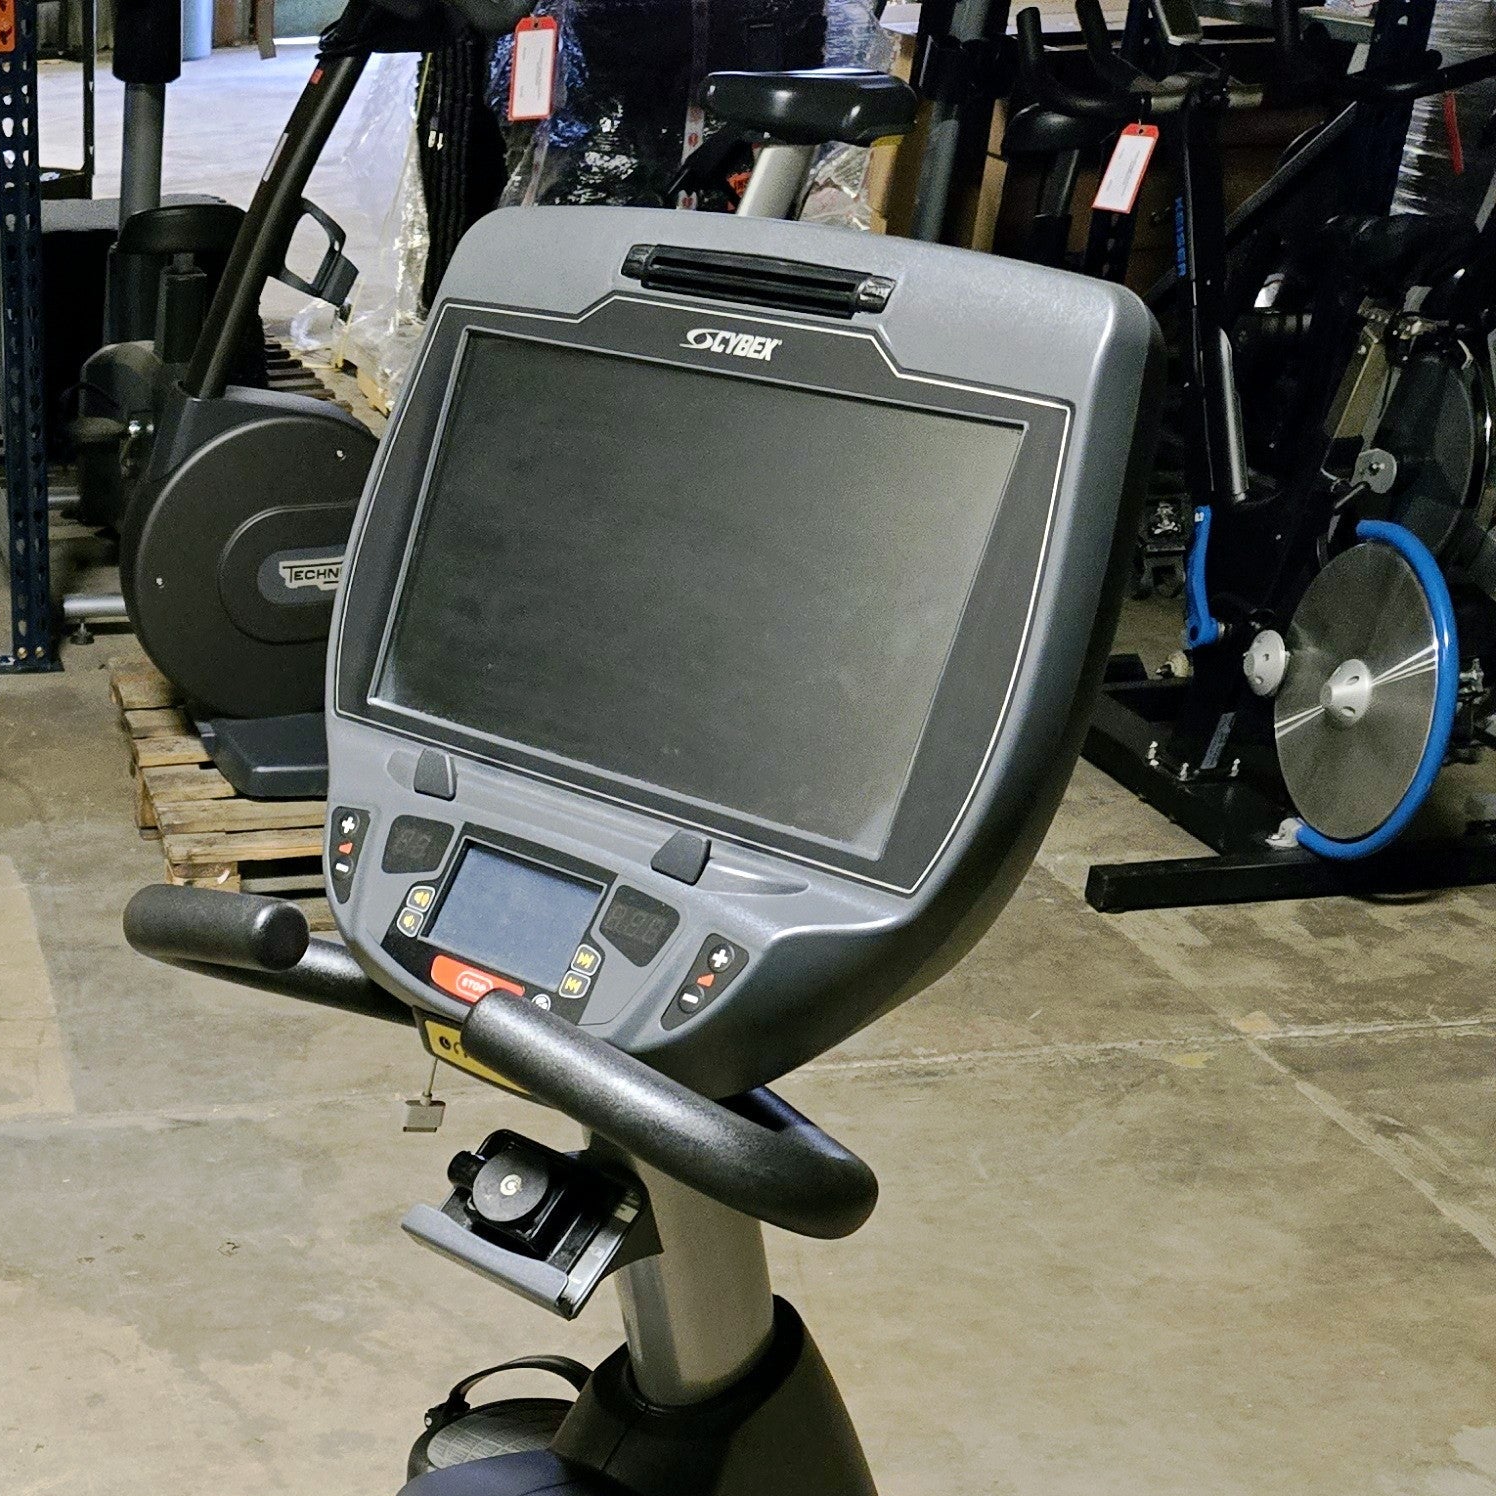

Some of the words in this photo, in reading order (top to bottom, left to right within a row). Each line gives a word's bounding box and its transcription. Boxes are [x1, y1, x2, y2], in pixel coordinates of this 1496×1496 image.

[710, 331, 783, 361] CYBEX
[282, 561, 343, 583] TECHN
[461, 976, 488, 993] STOP
